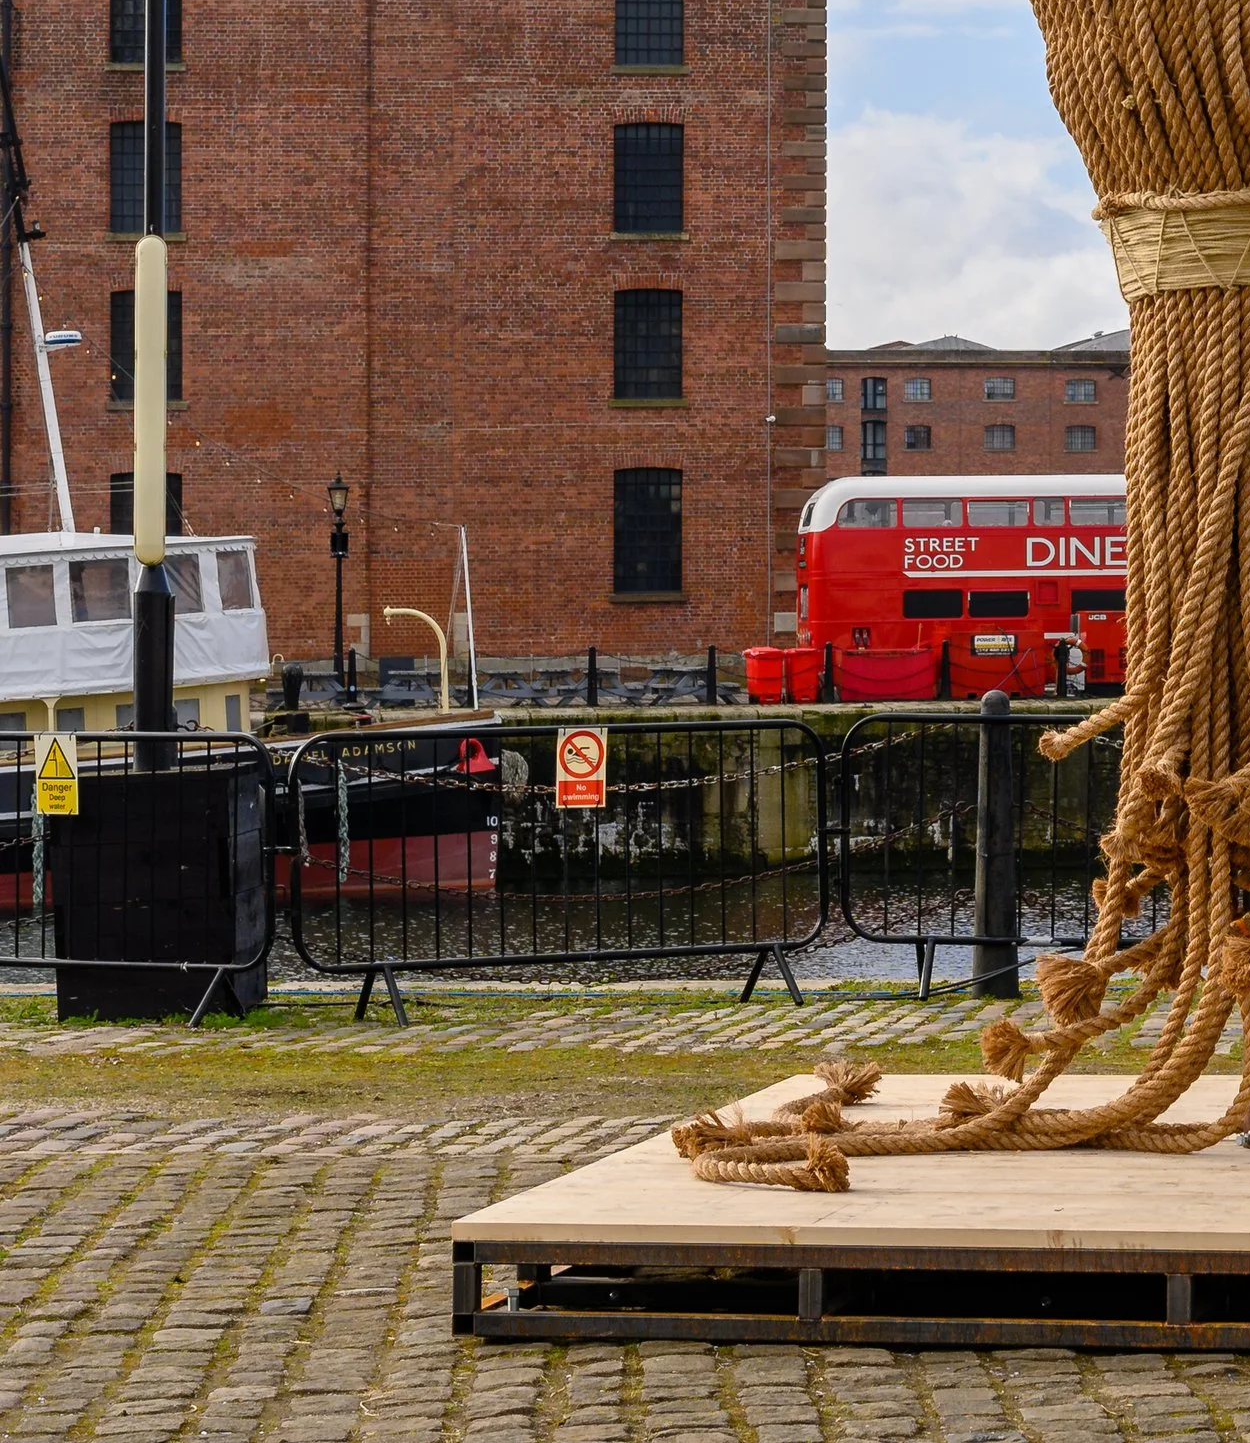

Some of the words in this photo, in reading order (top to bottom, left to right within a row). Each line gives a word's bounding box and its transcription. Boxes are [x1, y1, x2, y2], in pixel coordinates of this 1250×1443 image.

[904, 537, 980, 552] STREET
[1026, 536, 1127, 567] DINE
[904, 554, 964, 569] FOOD
[42, 782, 72, 793] Danger
[575, 783, 588, 792] No
[49, 794, 66, 802] Deep
[562, 794, 600, 802] swimming
[486, 816, 498, 827] 10
[490, 834, 498, 845] 9
[489, 851, 497, 862] 8
[488, 869, 496, 879] 7
